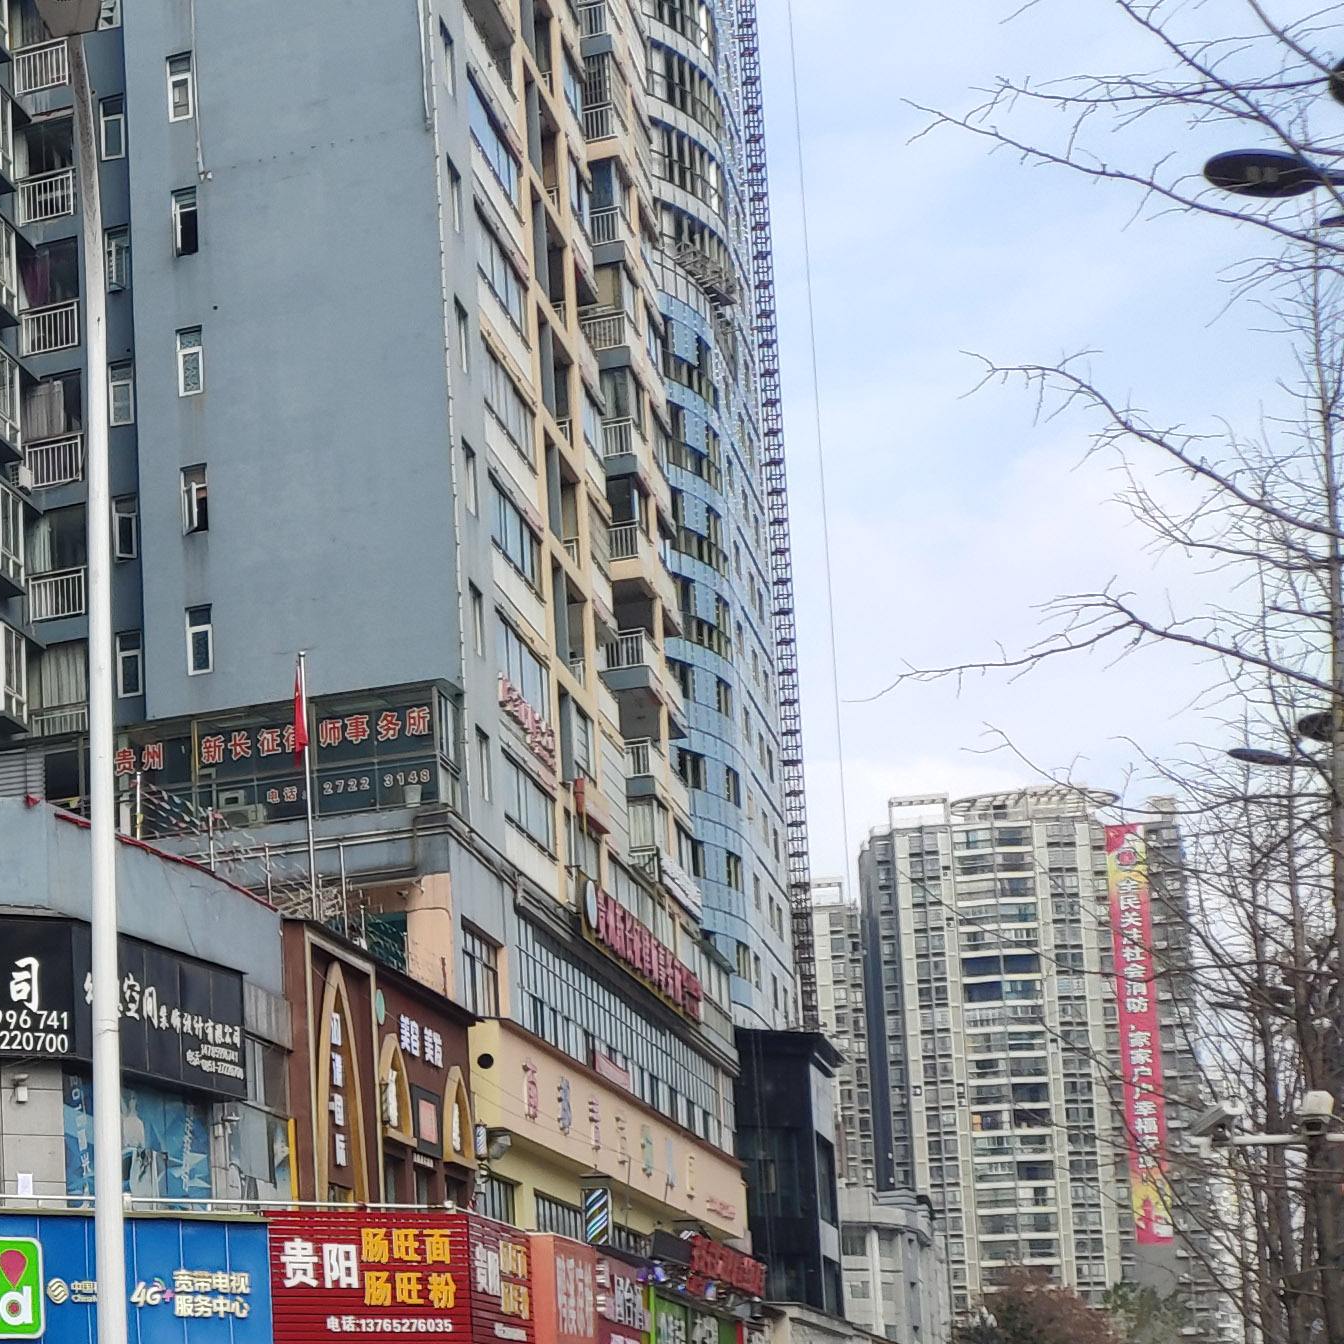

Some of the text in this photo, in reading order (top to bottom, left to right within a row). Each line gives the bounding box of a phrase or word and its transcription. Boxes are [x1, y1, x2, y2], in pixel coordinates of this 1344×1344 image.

[114, 742, 164, 777] 贵州
[319, 705, 431, 749] 师事务所
[323, 776, 370, 796] 2722
[383, 769, 430, 787] 3148
[361, 1227, 451, 1264] 肠旺面
[280, 1238, 360, 1288] 贵阳
[173, 1269, 251, 1294] 宽带电视
[364, 1271, 456, 1308] 肠旺粉
[174, 1295, 249, 1318] 服务中心
[359, 1318, 453, 1332] 13765276035
